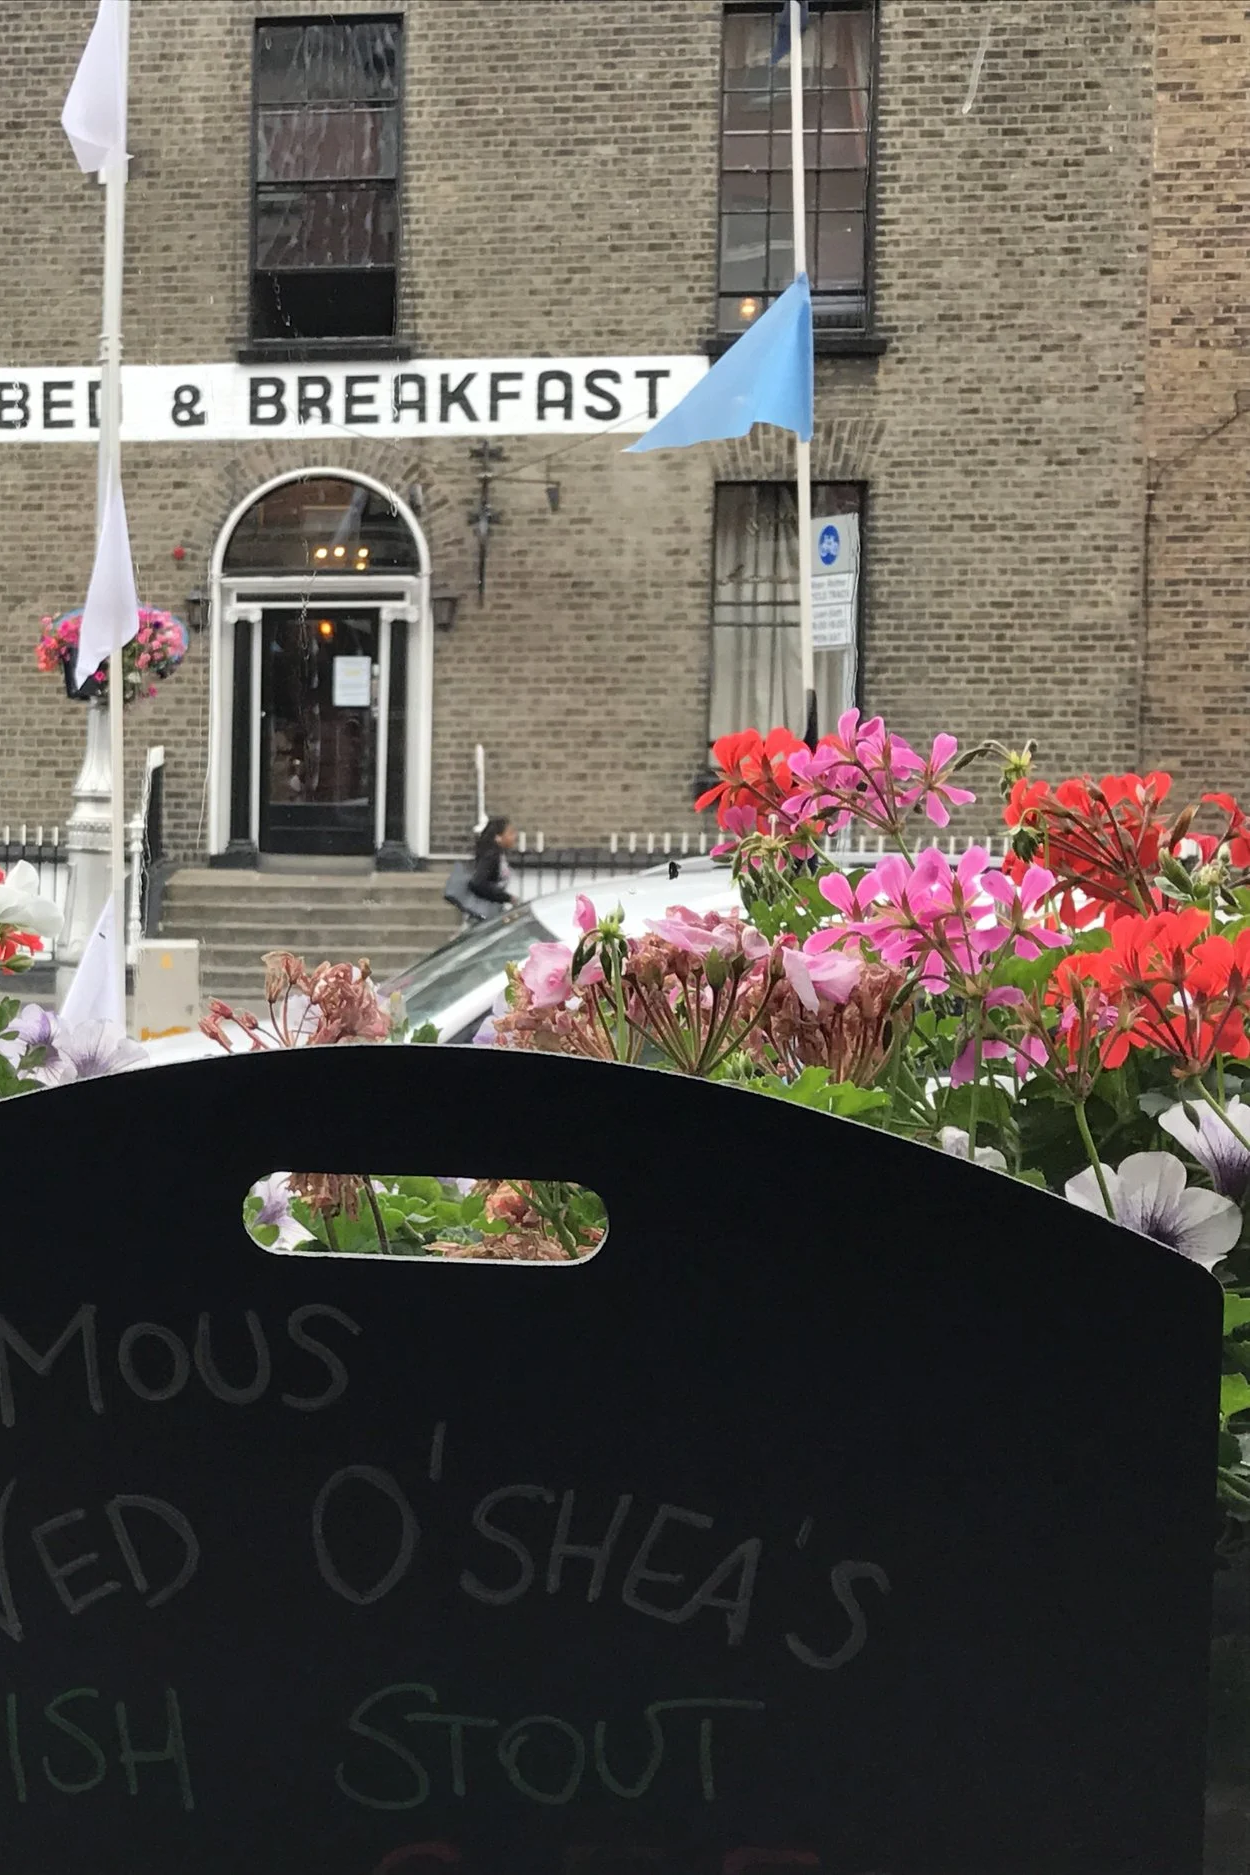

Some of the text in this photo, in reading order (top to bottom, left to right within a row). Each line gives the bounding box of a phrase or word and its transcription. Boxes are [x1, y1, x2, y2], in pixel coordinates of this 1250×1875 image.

[171, 384, 206, 427] &
[249, 369, 670, 426] BREAKFAST
[311, 1421, 891, 1672] O'SHEA'S
[334, 1681, 765, 1811] STOUT
